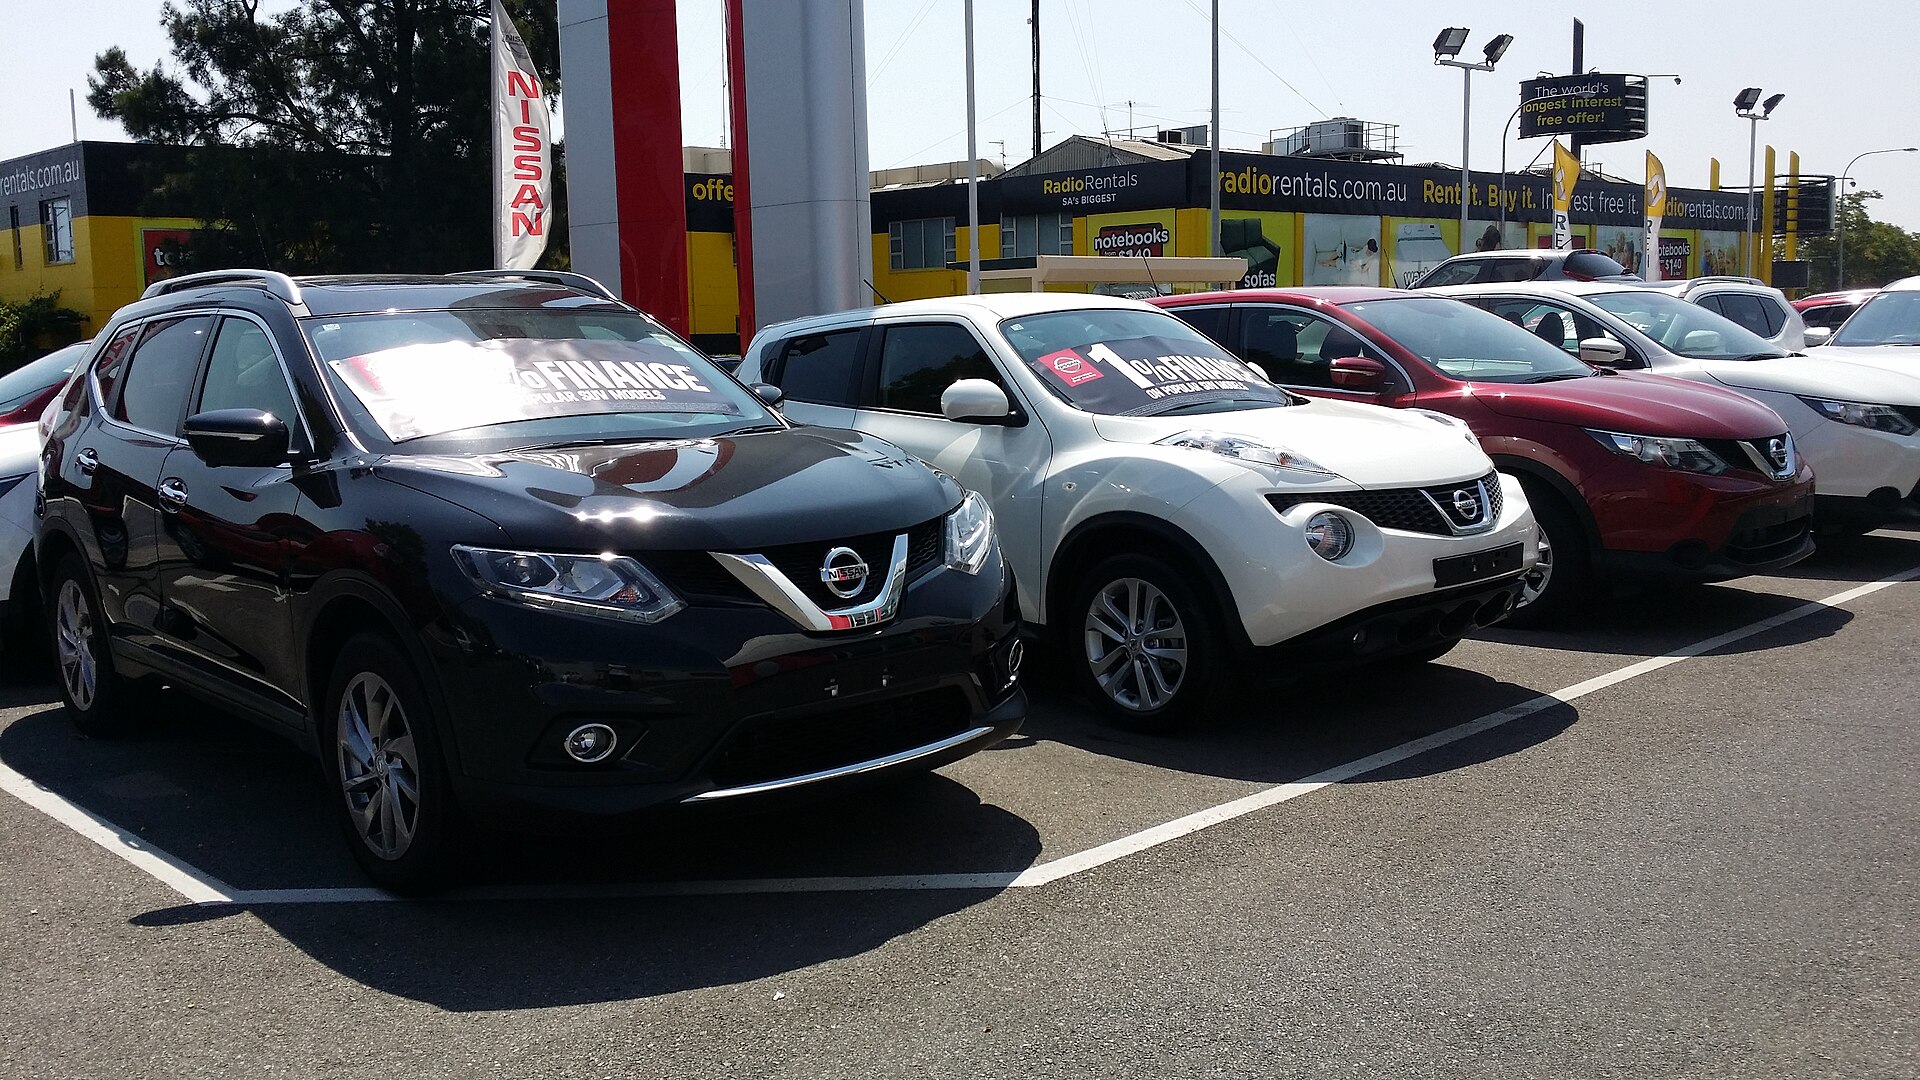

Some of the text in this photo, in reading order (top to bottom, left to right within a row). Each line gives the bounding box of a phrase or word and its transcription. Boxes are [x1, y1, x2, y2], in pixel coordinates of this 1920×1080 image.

[1535, 82, 1609, 97] The world's
[1571, 96, 1622, 108] interest
[1536, 112, 1605, 126] free offer!
[507, 70, 544, 237] NISSAN
[692, 178, 734, 201] offe
[1219, 166, 1407, 202] radiorentals.com.au
[1062, 193, 1117, 206] SA's BIGGEST
[1423, 179, 1461, 205] Rent
[1522, 185, 1537, 209] it.
[1599, 189, 1624, 214] free
[1628, 193, 1640, 215] it.
[1094, 227, 1169, 250] notebooks
[1243, 271, 1276, 288] sofas
[579, 388, 609, 401] SUV
[608, 388, 667, 401] MODELS
[1159, 381, 1203, 396] POPULAR
[828, 565, 867, 579] NISSAN
